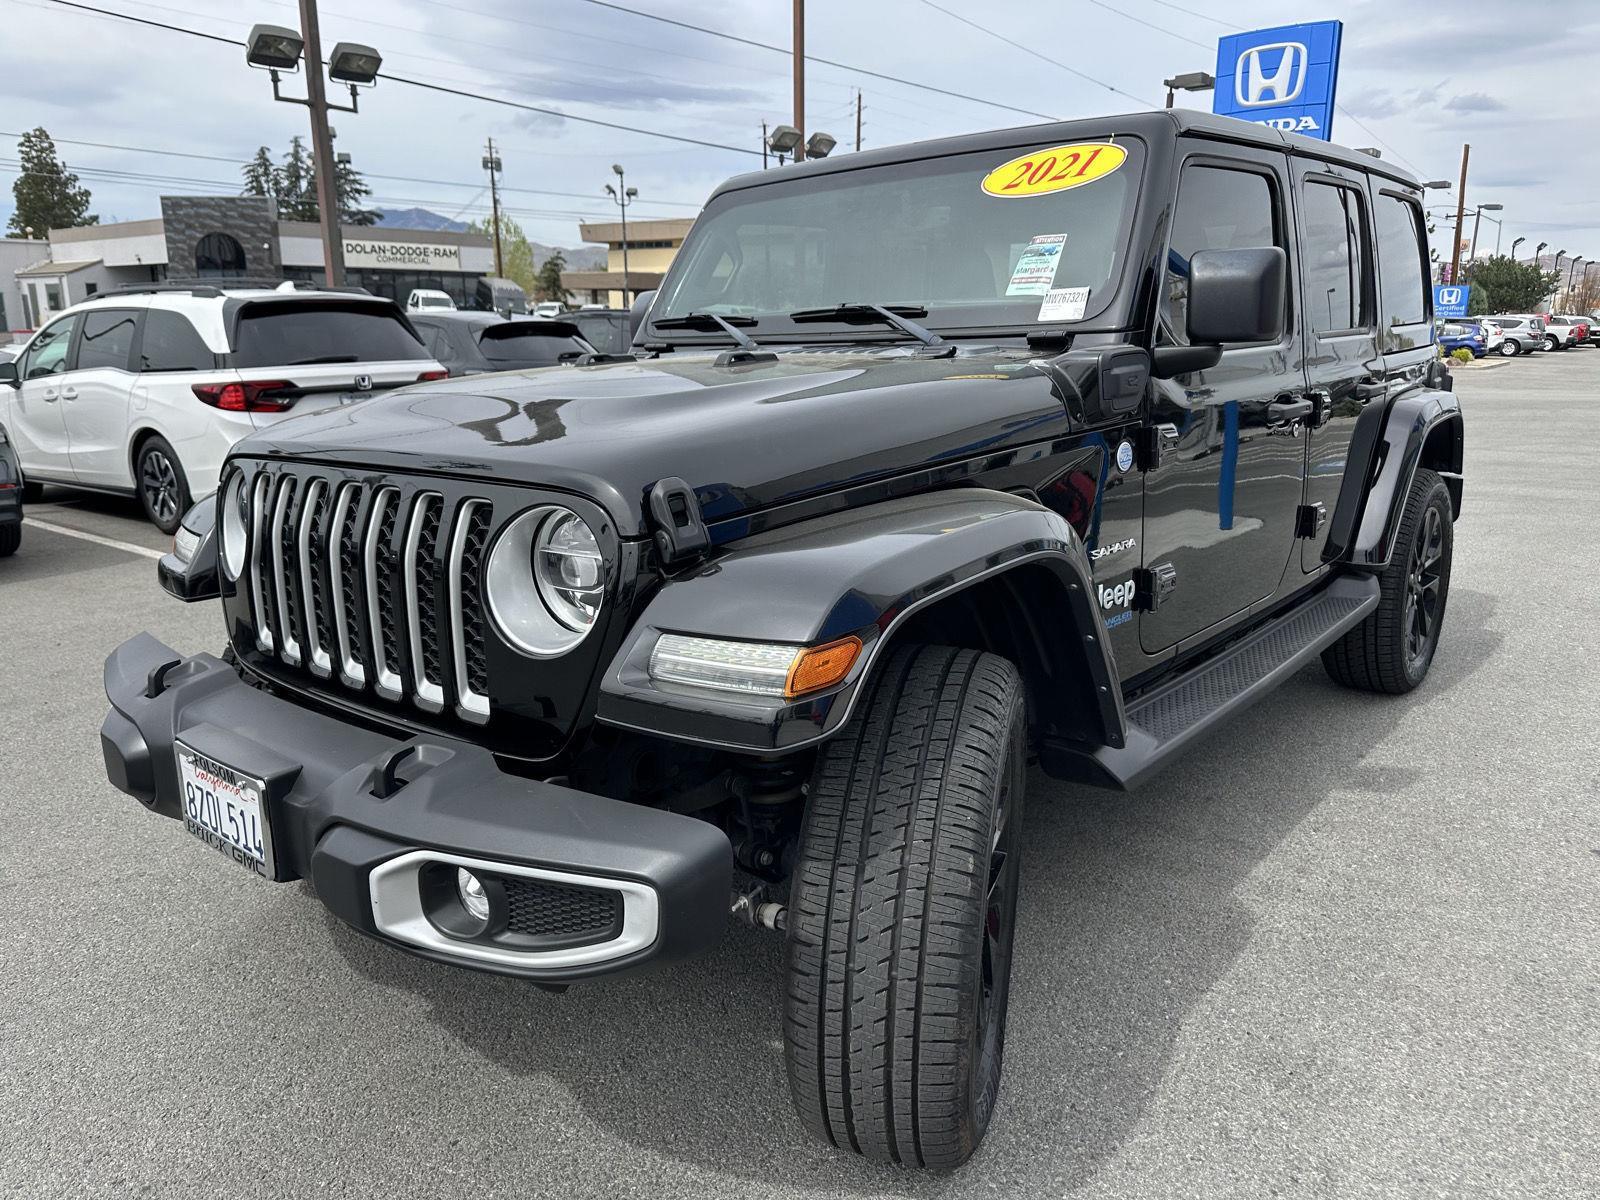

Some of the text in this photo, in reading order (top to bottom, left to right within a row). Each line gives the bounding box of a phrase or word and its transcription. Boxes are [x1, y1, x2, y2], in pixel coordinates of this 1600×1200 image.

[1001, 147, 1103, 190] 2021
[345, 243, 458, 259] DOLAN-DODGE-RAM
[376, 255, 431, 265] COMMERCIAL
[1090, 538, 1137, 560] SAHARA
[1098, 579, 1136, 610] Jeep
[193, 751, 238, 786] FOLSOM
[231, 845, 267, 878] GMC
